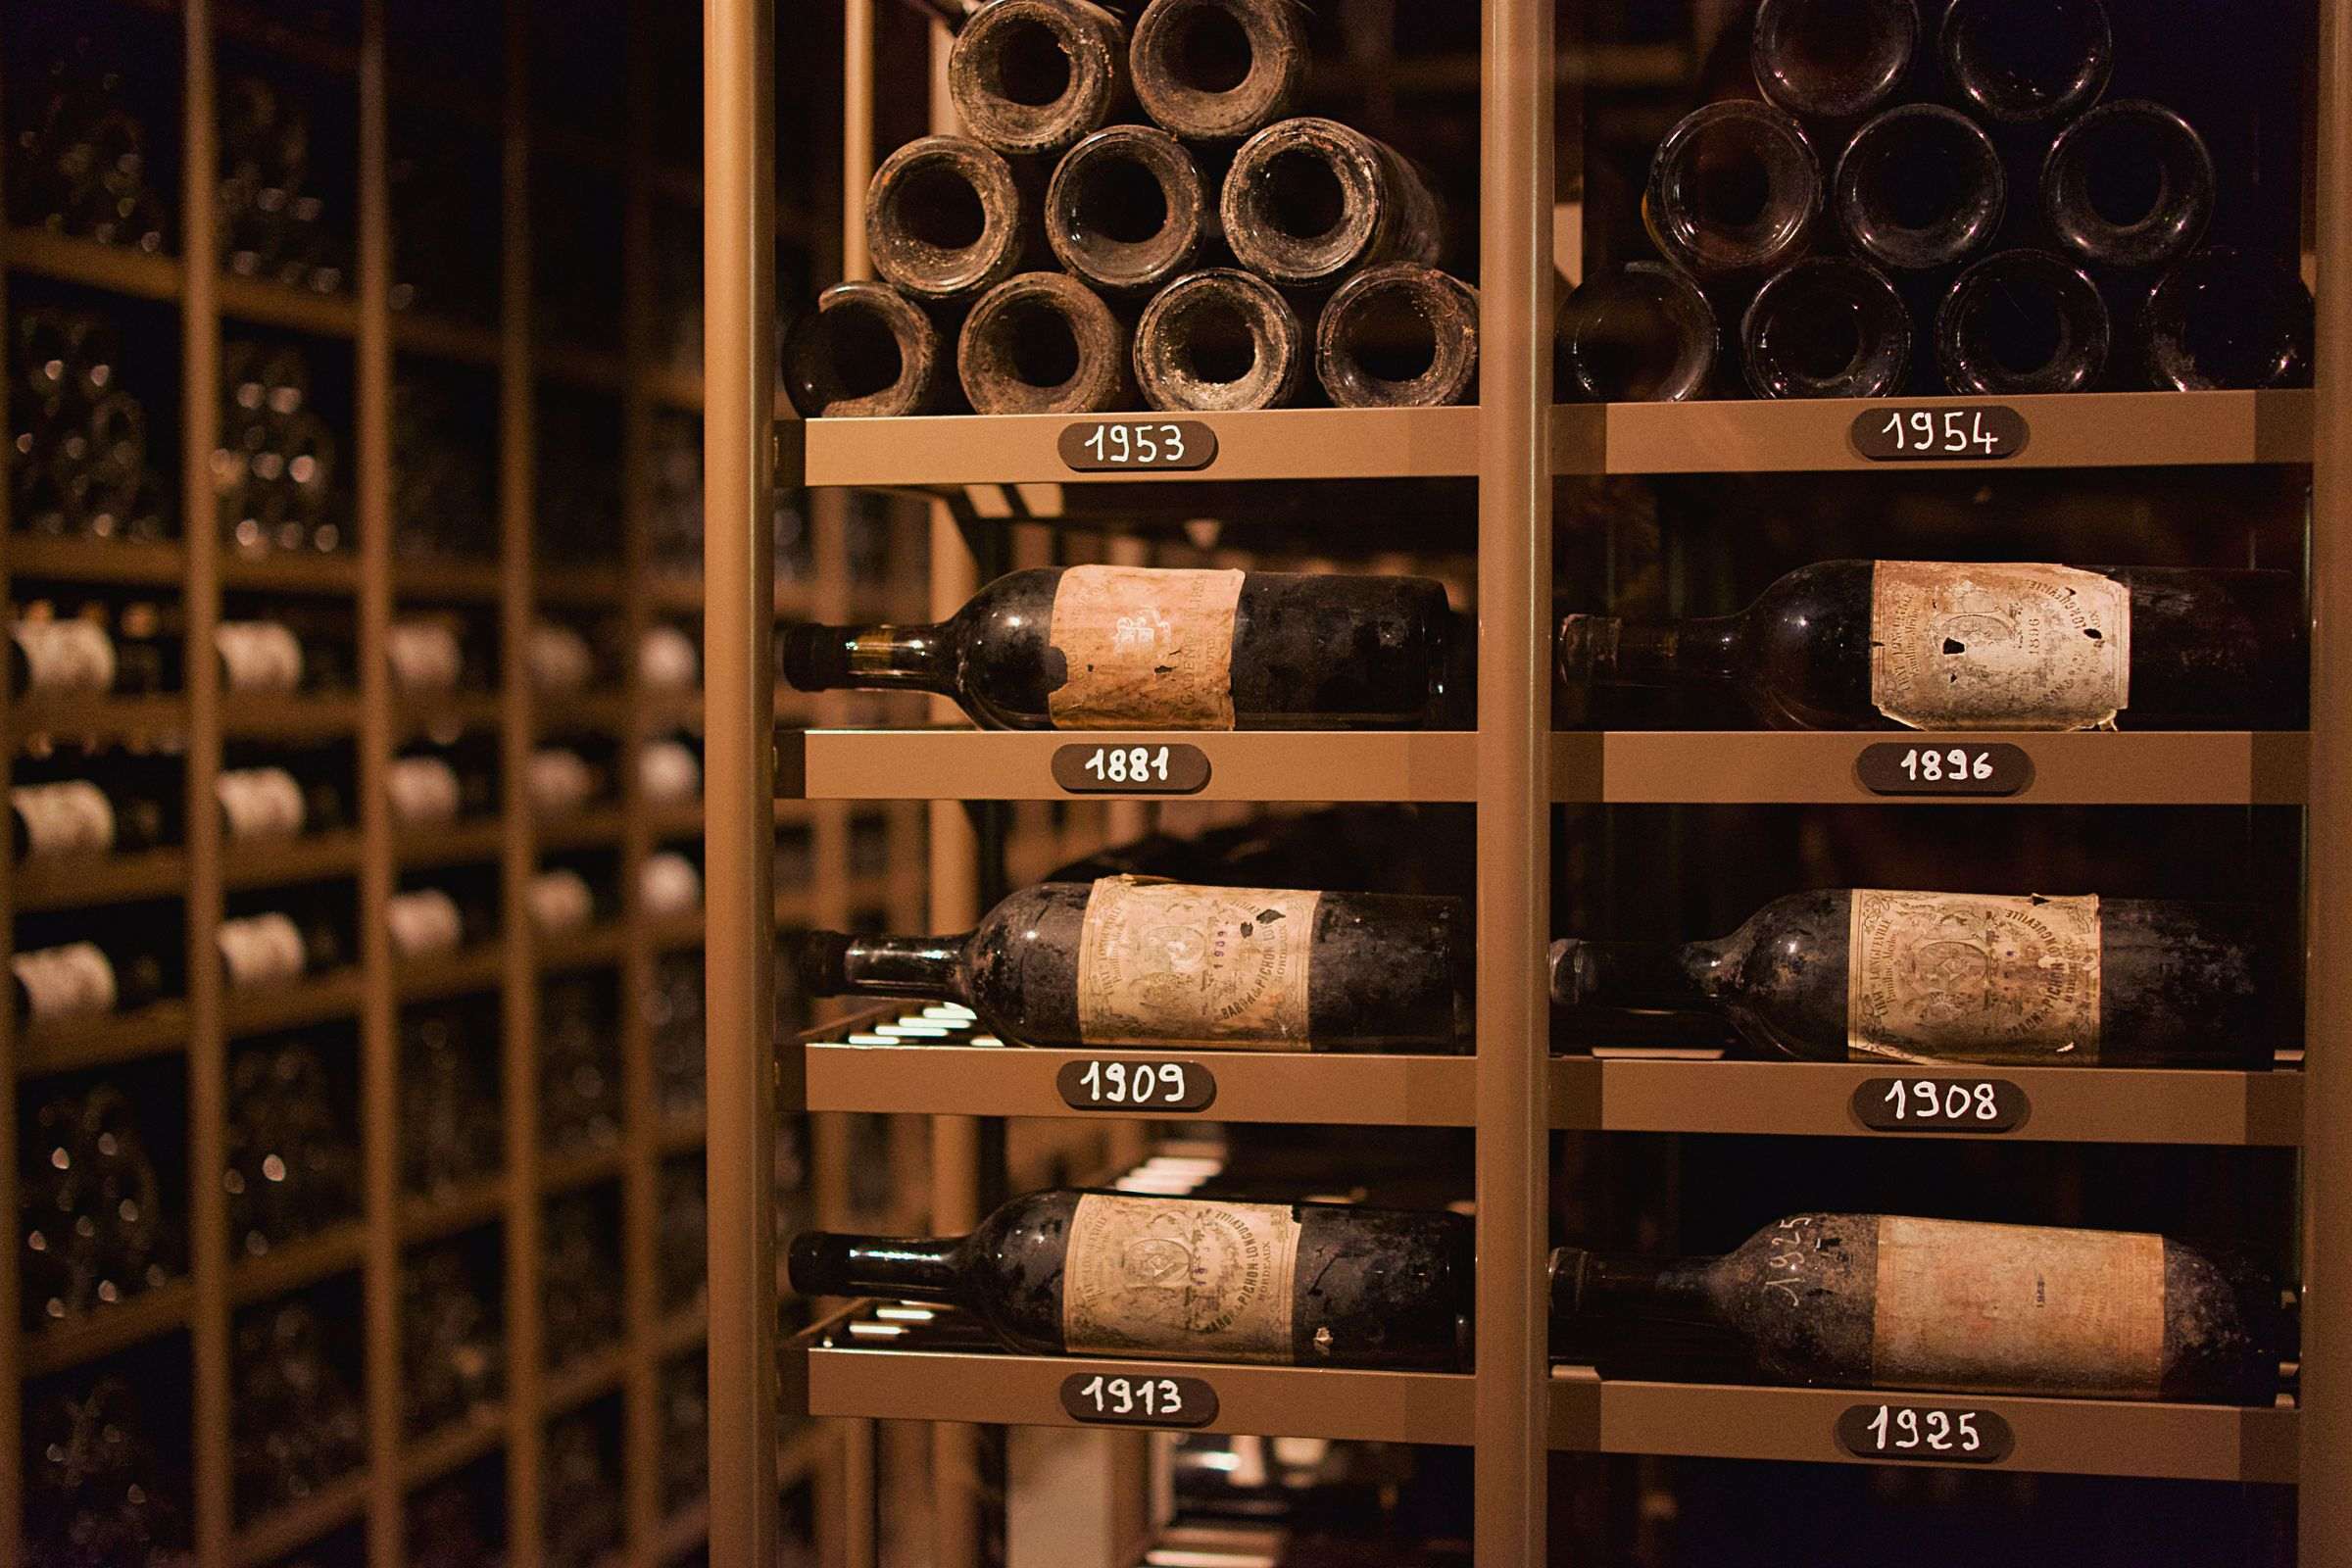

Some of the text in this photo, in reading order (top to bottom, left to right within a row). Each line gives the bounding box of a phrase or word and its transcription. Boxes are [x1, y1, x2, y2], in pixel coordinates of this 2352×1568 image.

[1085, 425, 1184, 462] 1953
[1883, 412, 1998, 454] 1954
[2028, 618, 2040, 655] 1896
[1085, 747, 1168, 781] 1881
[1901, 750, 1992, 780] 1896
[1080, 1061, 1184, 1102] 1909
[1886, 1080, 1996, 1119] 1908
[1762, 1217, 1812, 1307] 1925
[1082, 1377, 1181, 1415] 1913
[1868, 1405, 1979, 1450] 1925
